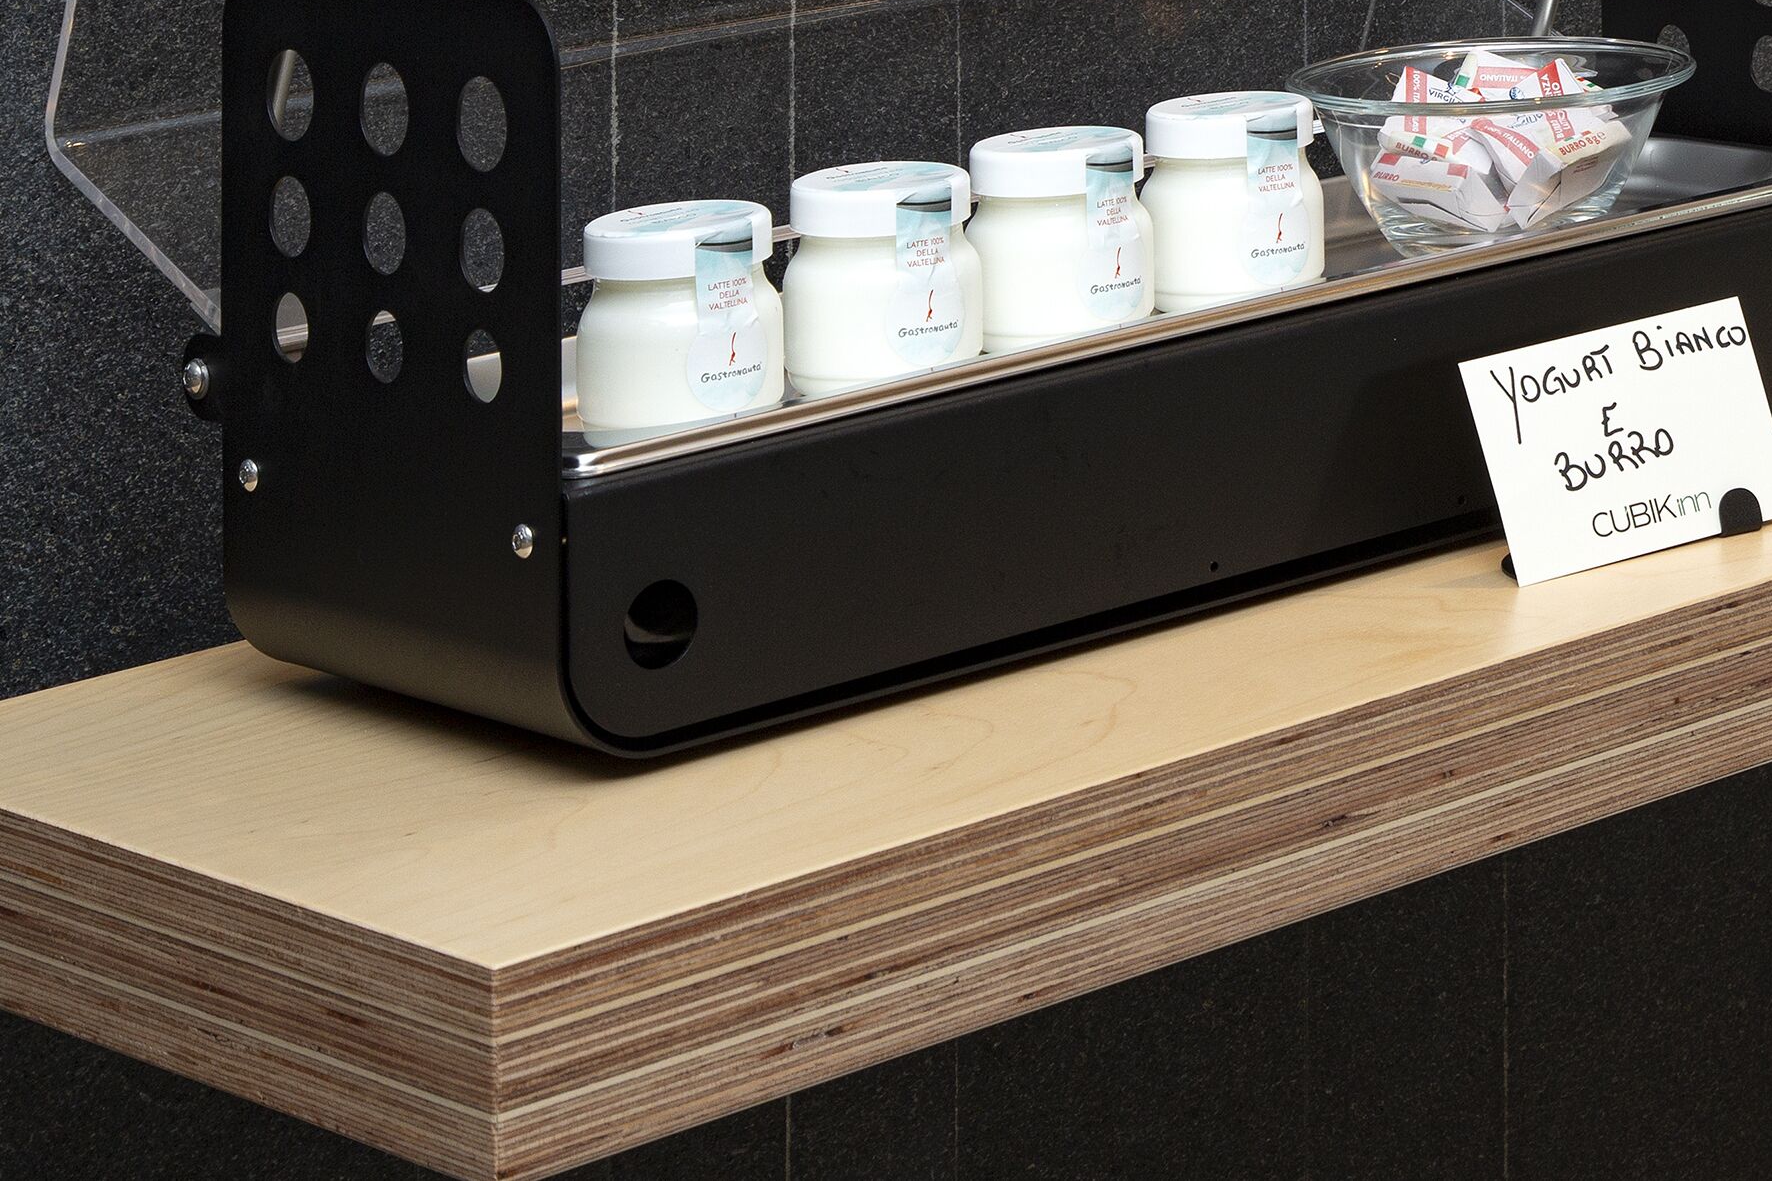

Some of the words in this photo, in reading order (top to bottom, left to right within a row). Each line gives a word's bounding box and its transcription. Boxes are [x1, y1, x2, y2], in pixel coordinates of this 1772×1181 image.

[1479, 73, 1518, 83] ITALIANO
[1395, 141, 1429, 161] BURRO
[1502, 132, 1535, 159] ITALIANO
[1558, 139, 1587, 156] BURRO
[1257, 165, 1276, 175] LATTE
[1277, 163, 1293, 172] 100%
[1373, 171, 1400, 182] BURRO
[1265, 174, 1286, 182] DELLA
[1258, 181, 1295, 192] VALTELLINA
[1096, 198, 1115, 209] LATTE
[906, 238, 929, 249] LATTE
[1250, 242, 1305, 259] Gastronauta
[916, 247, 939, 257] DELLA
[907, 256, 945, 268] VALTELLINA
[707, 279, 731, 291] LATTE
[731, 276, 747, 287] 100%
[1090, 277, 1141, 295] Gastronauta
[719, 289, 740, 300] DELLA
[708, 296, 749, 311] VALTELLINA
[898, 320, 958, 338] Gastronauta
[700, 362, 762, 384] Gastronauta
[1489, 344, 1613, 446] YOGURT
[1600, 402, 1625, 437] E
[1553, 428, 1674, 492] BURRO
